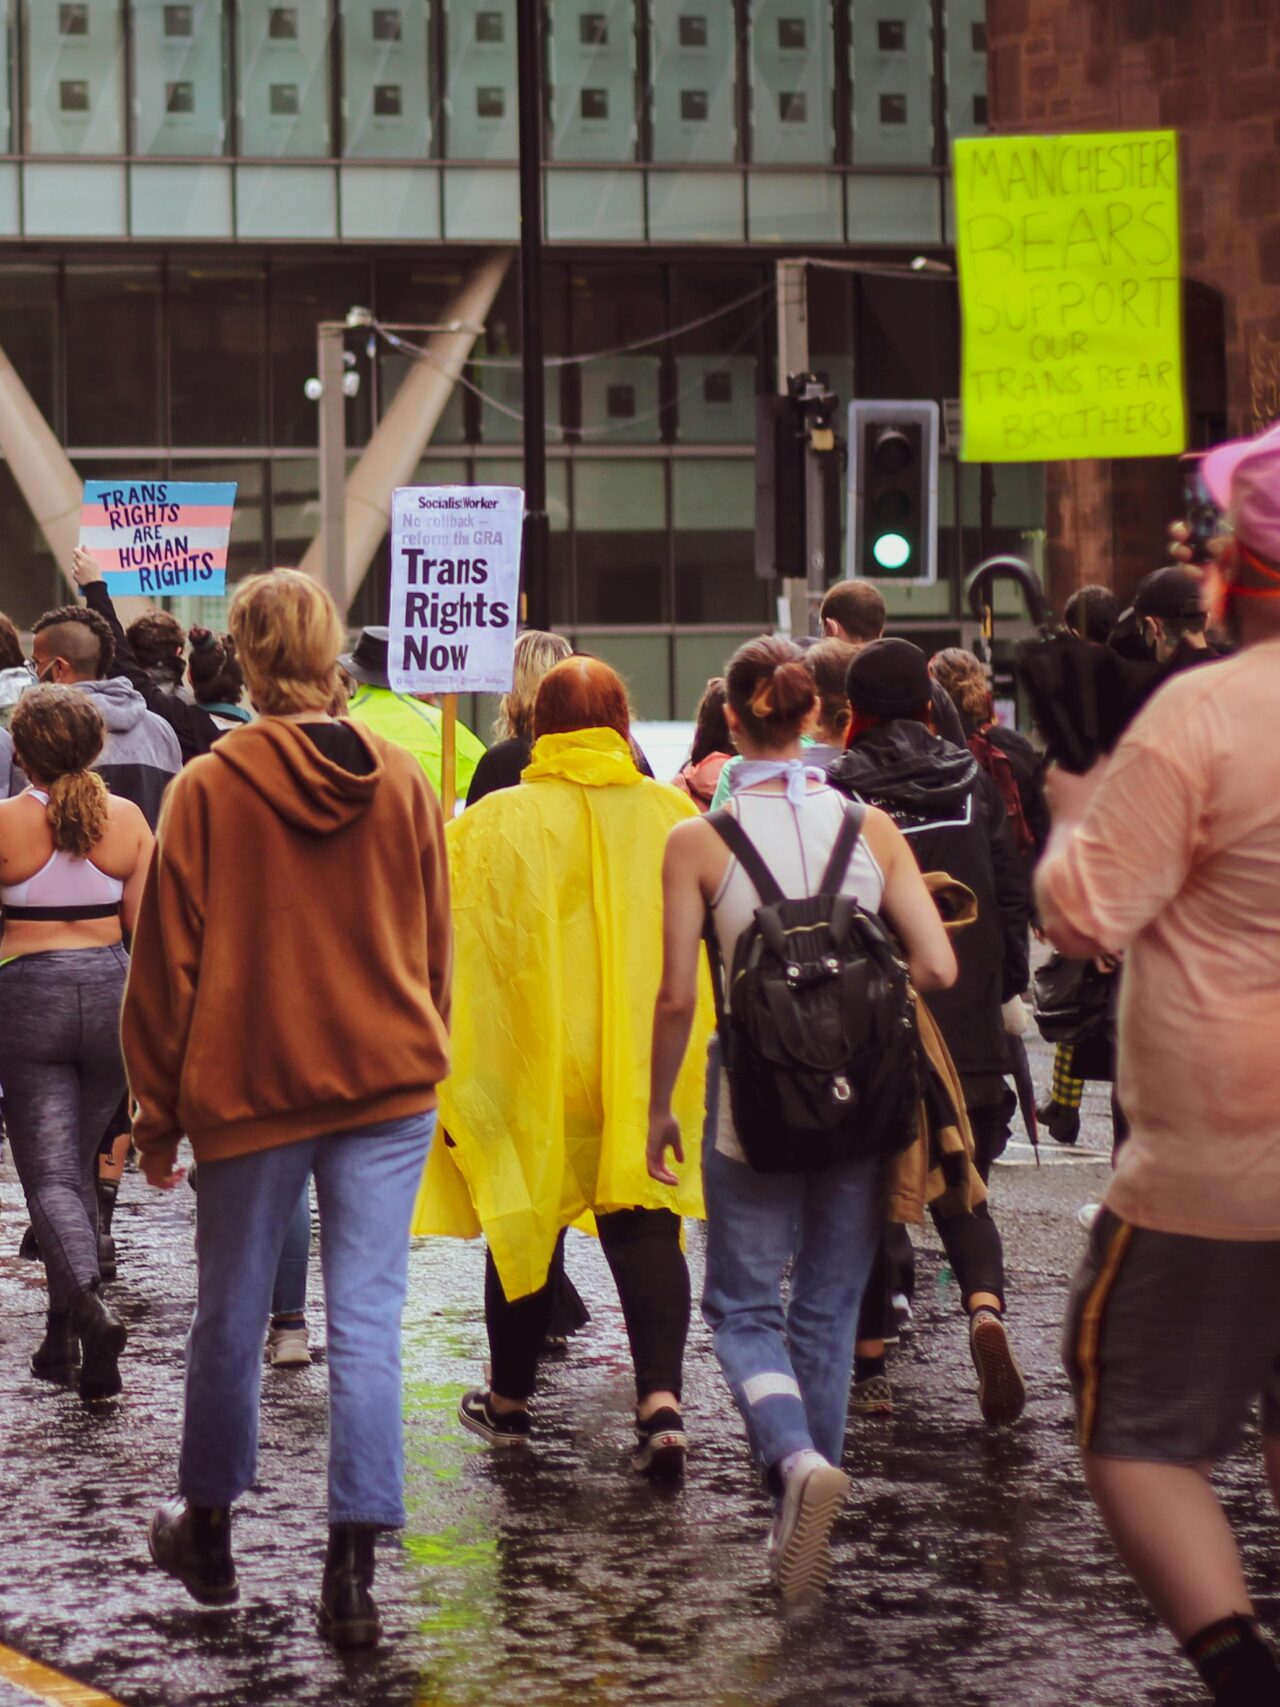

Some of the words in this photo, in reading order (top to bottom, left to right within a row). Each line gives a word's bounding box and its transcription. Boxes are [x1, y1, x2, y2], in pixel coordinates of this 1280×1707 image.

[970, 139, 1173, 202] MANCHESTER
[968, 201, 1173, 281] BEARS
[973, 276, 1177, 335] SUPPORT
[1030, 331, 1088, 362] OUR
[970, 366, 1083, 404] TRANS
[1098, 361, 1173, 392] BEAR
[1002, 401, 1171, 450] BROTHERS
[98, 484, 168, 512] TRANS
[109, 503, 180, 530] RIGHTS
[462, 496, 499, 509] Worker
[133, 525, 163, 544] ARE
[401, 531, 449, 545] reform
[453, 531, 470, 545] the
[473, 530, 503, 545] GRA
[402, 513, 421, 528] No
[426, 513, 474, 528] rollback
[119, 535, 189, 568] HUMAN
[401, 548, 488, 585] Trans
[139, 552, 214, 592] RIGHTS
[404, 592, 510, 635] Rights
[402, 634, 469, 671] Now
